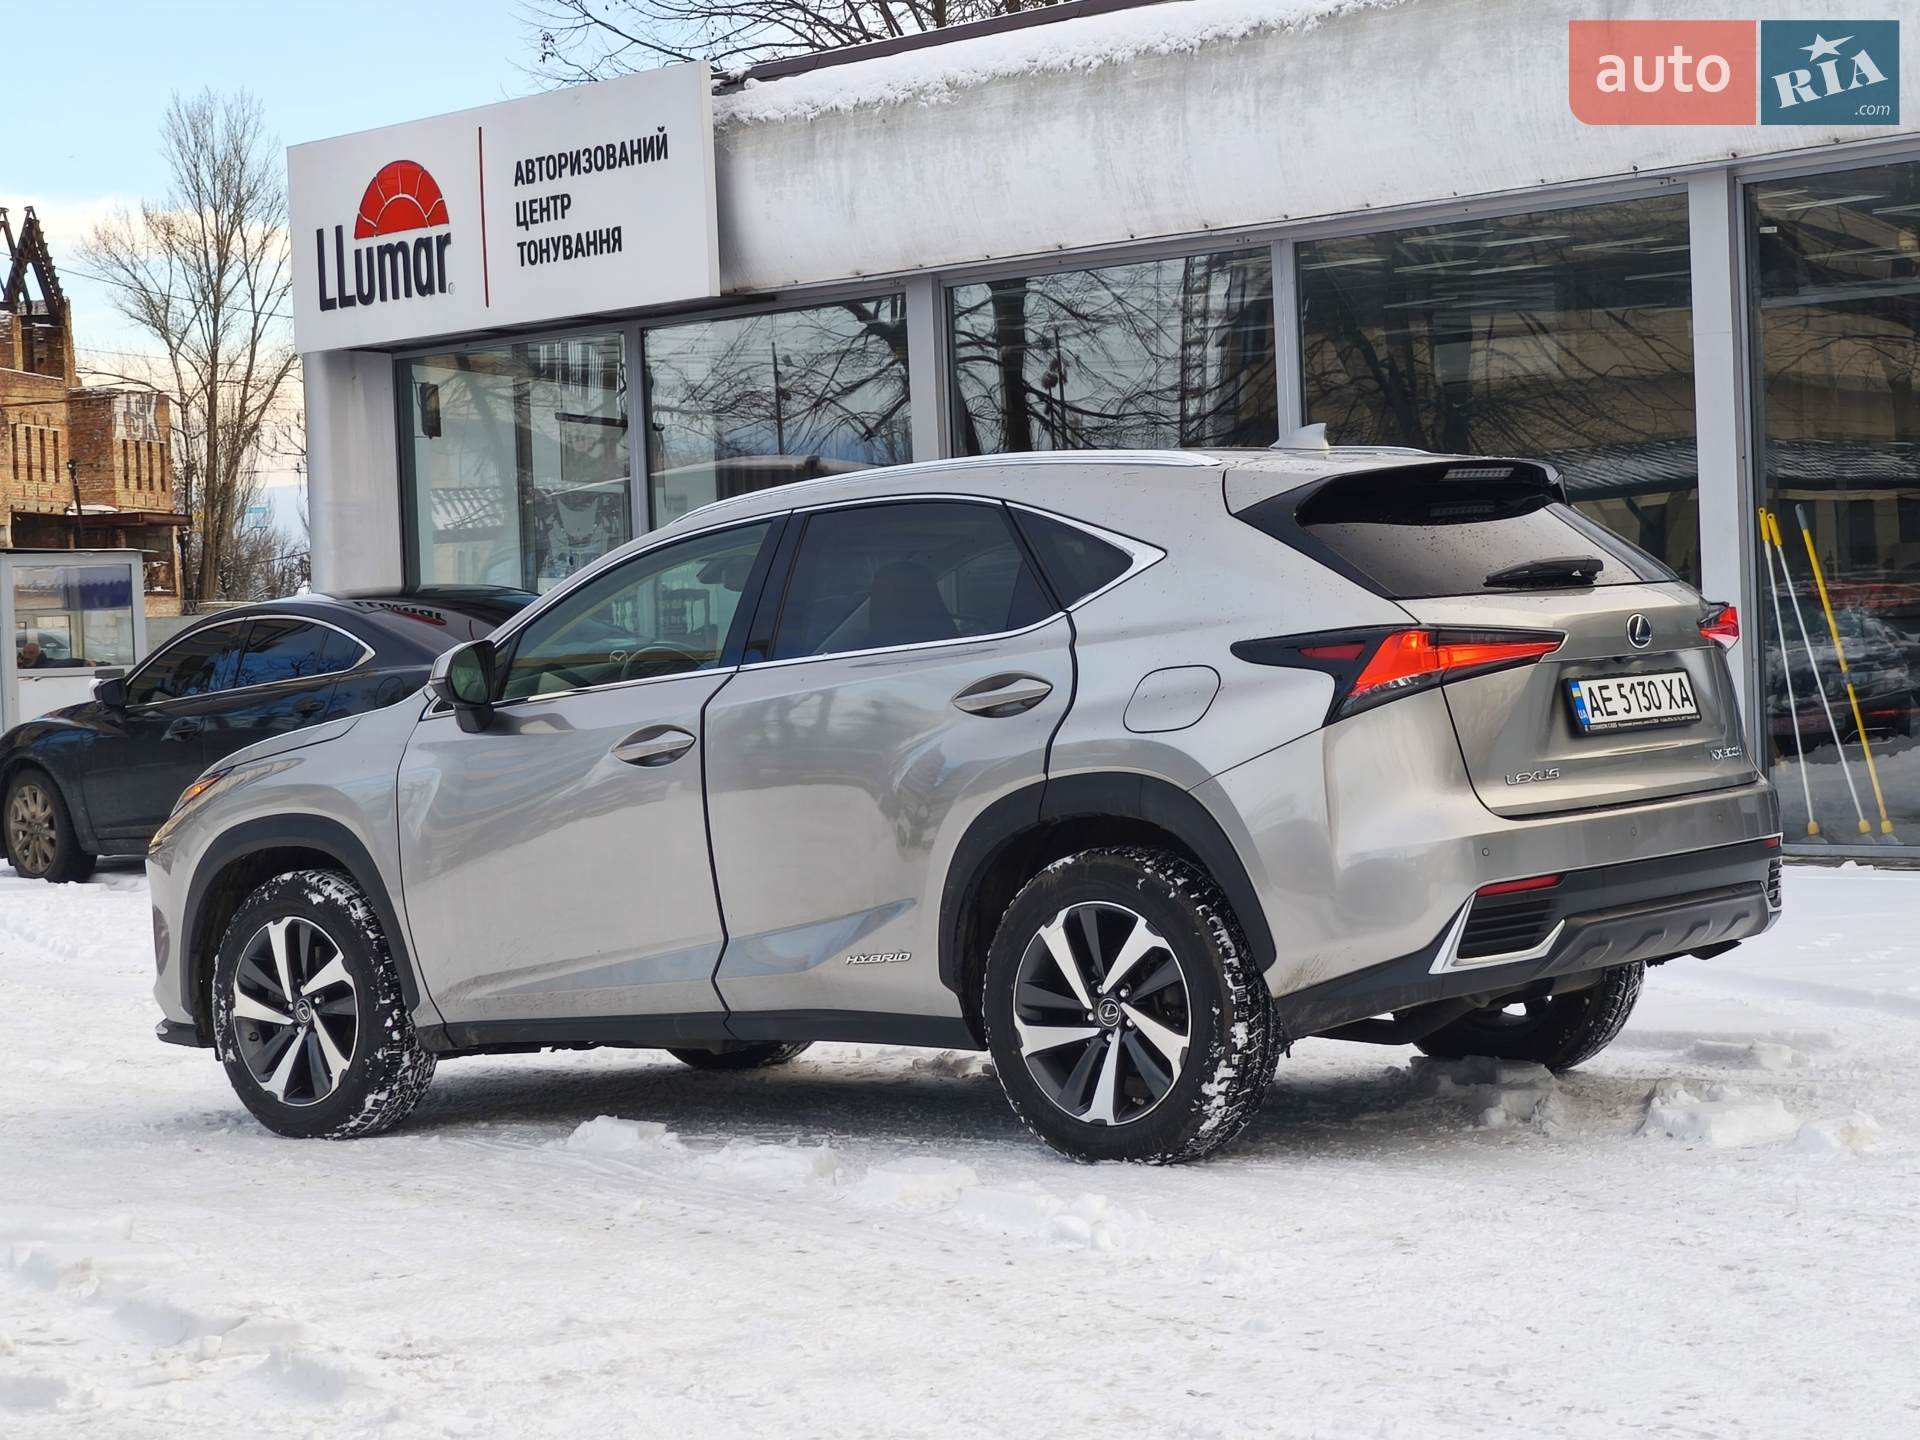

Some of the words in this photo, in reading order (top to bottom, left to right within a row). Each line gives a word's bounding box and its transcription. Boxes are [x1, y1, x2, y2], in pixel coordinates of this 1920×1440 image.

[513, 126, 669, 187] АВТОРИЗОВАНИЙ
[515, 193, 573, 232] ЦЕНТР
[516, 225, 623, 268] ТОНУВАННЯ
[316, 224, 452, 312] LLumar
[1578, 709, 1589, 720] UA
[1587, 684, 1618, 719] AE
[1616, 679, 1662, 715] 5130
[1661, 677, 1694, 710] XA
[1505, 767, 1560, 786] LEXUS
[845, 952, 912, 965] HYBRID
